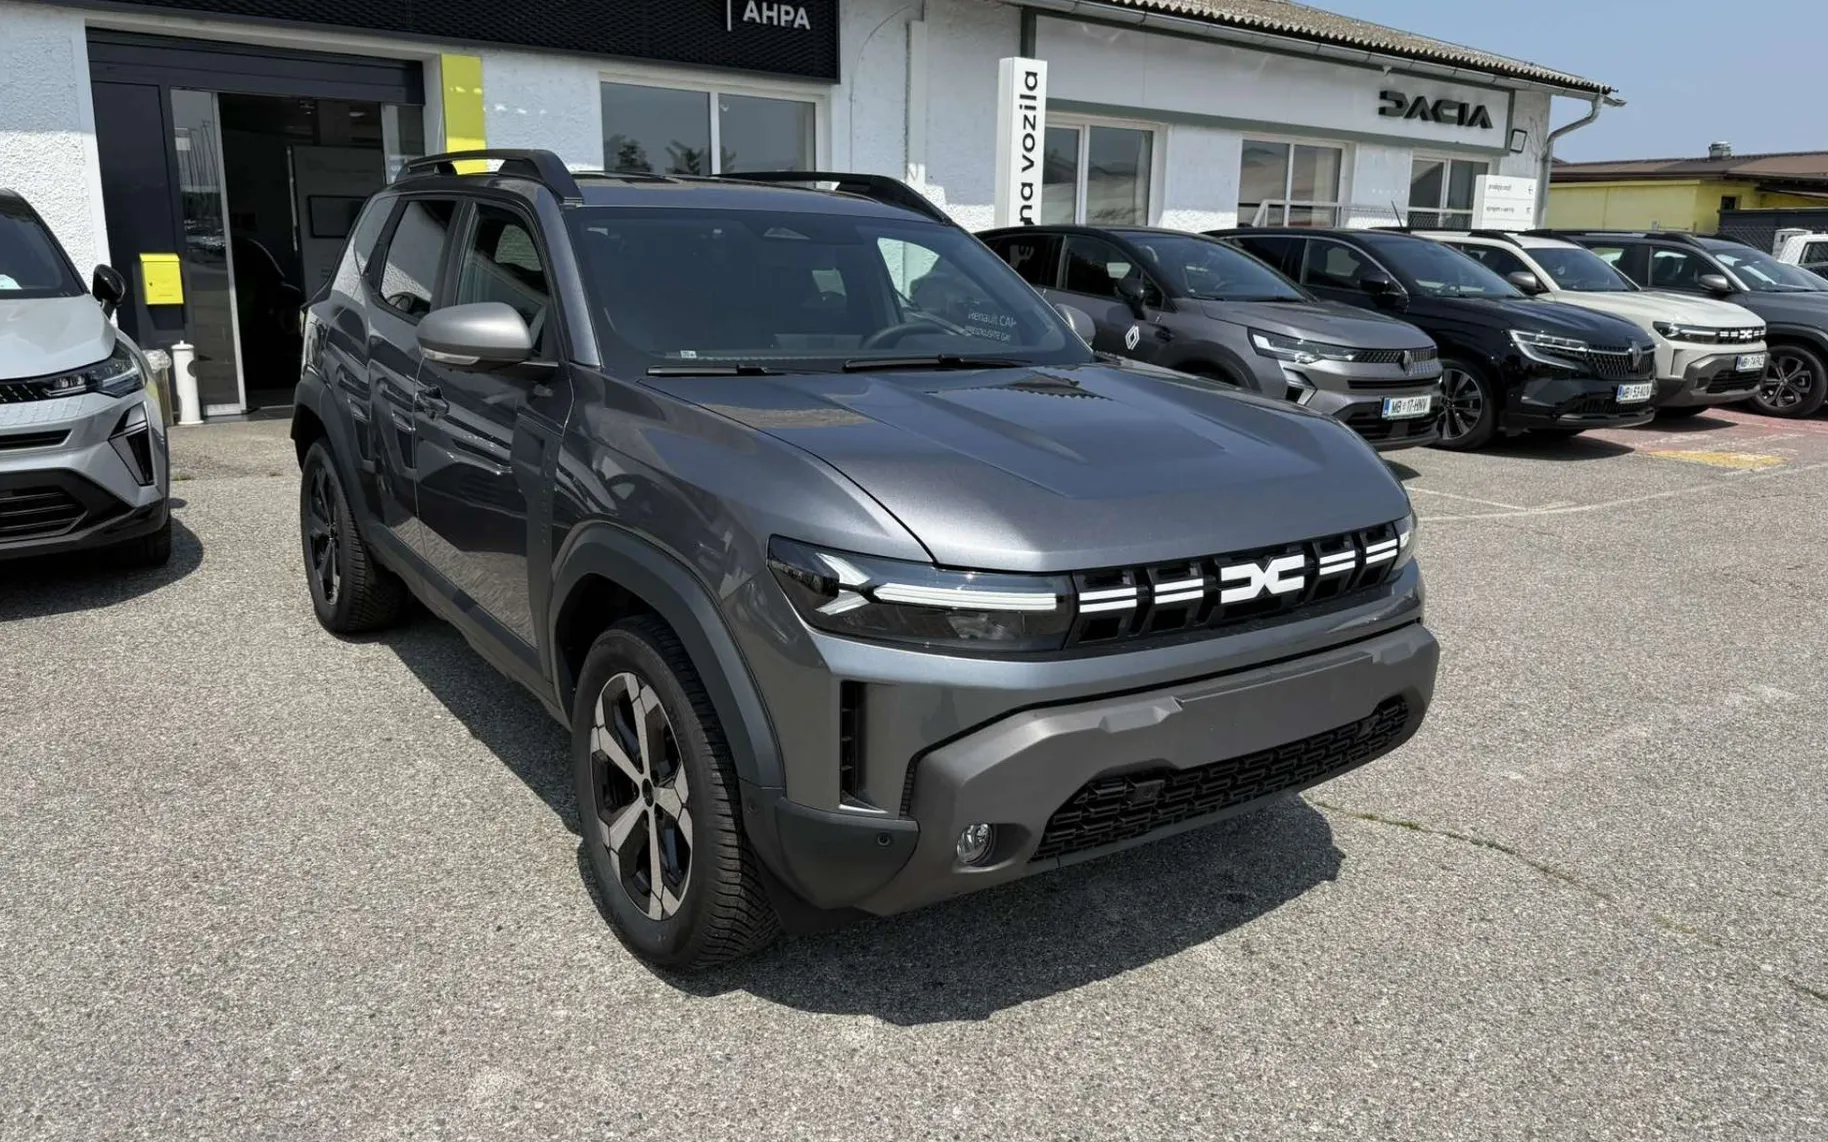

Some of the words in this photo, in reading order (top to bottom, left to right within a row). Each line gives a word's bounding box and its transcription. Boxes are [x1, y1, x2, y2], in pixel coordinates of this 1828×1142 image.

[743, 0, 811, 30] AHPA
[1019, 71, 1038, 172] vozila
[1378, 90, 1493, 129] DACIA
